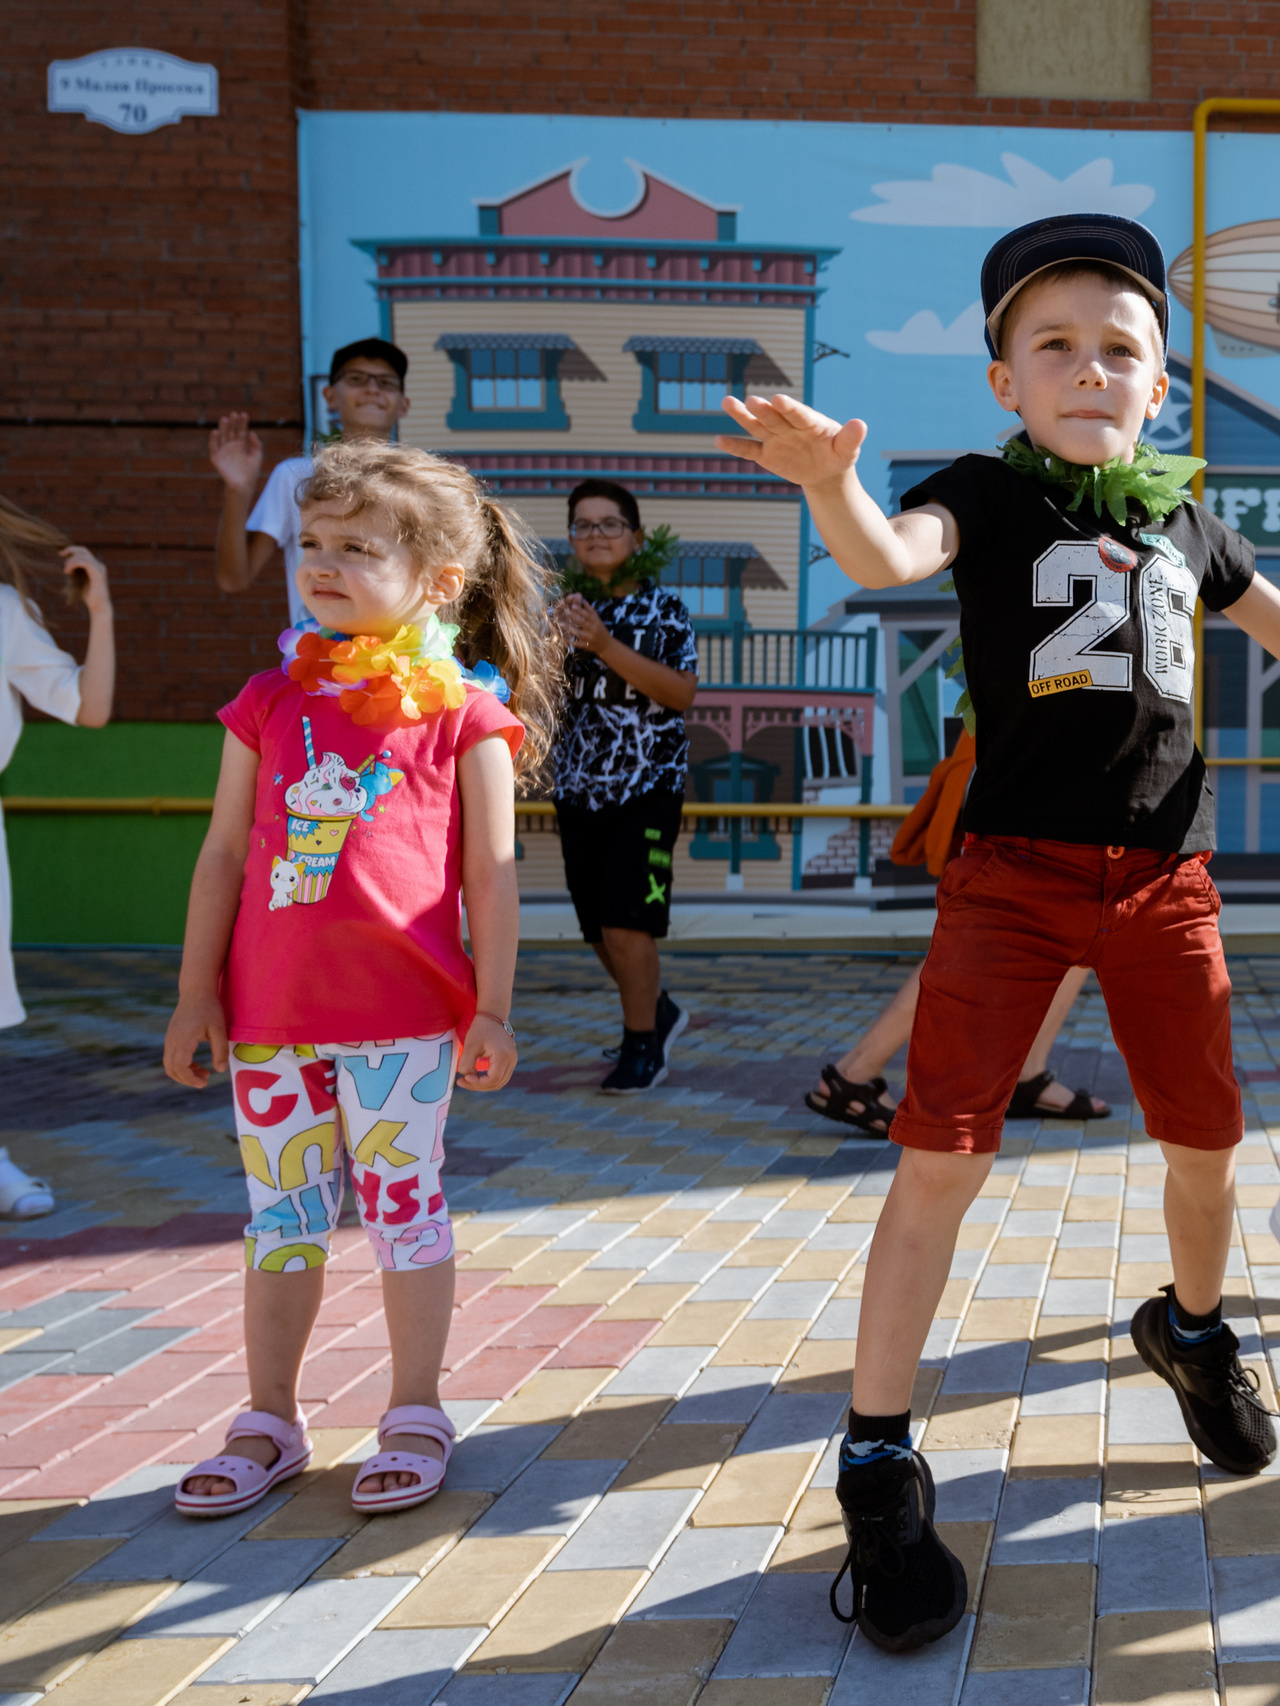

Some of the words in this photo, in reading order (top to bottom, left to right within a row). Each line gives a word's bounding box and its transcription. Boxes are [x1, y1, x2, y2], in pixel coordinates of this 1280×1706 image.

[119, 103, 148, 124] 70
[1148, 572, 1167, 622] ZONE
[1154, 627, 1168, 674] WORK
[1031, 681, 1051, 694] OFF
[1054, 673, 1088, 690] ROAD
[291, 818, 311, 832] ICE
[298, 854, 337, 867] CREAM
